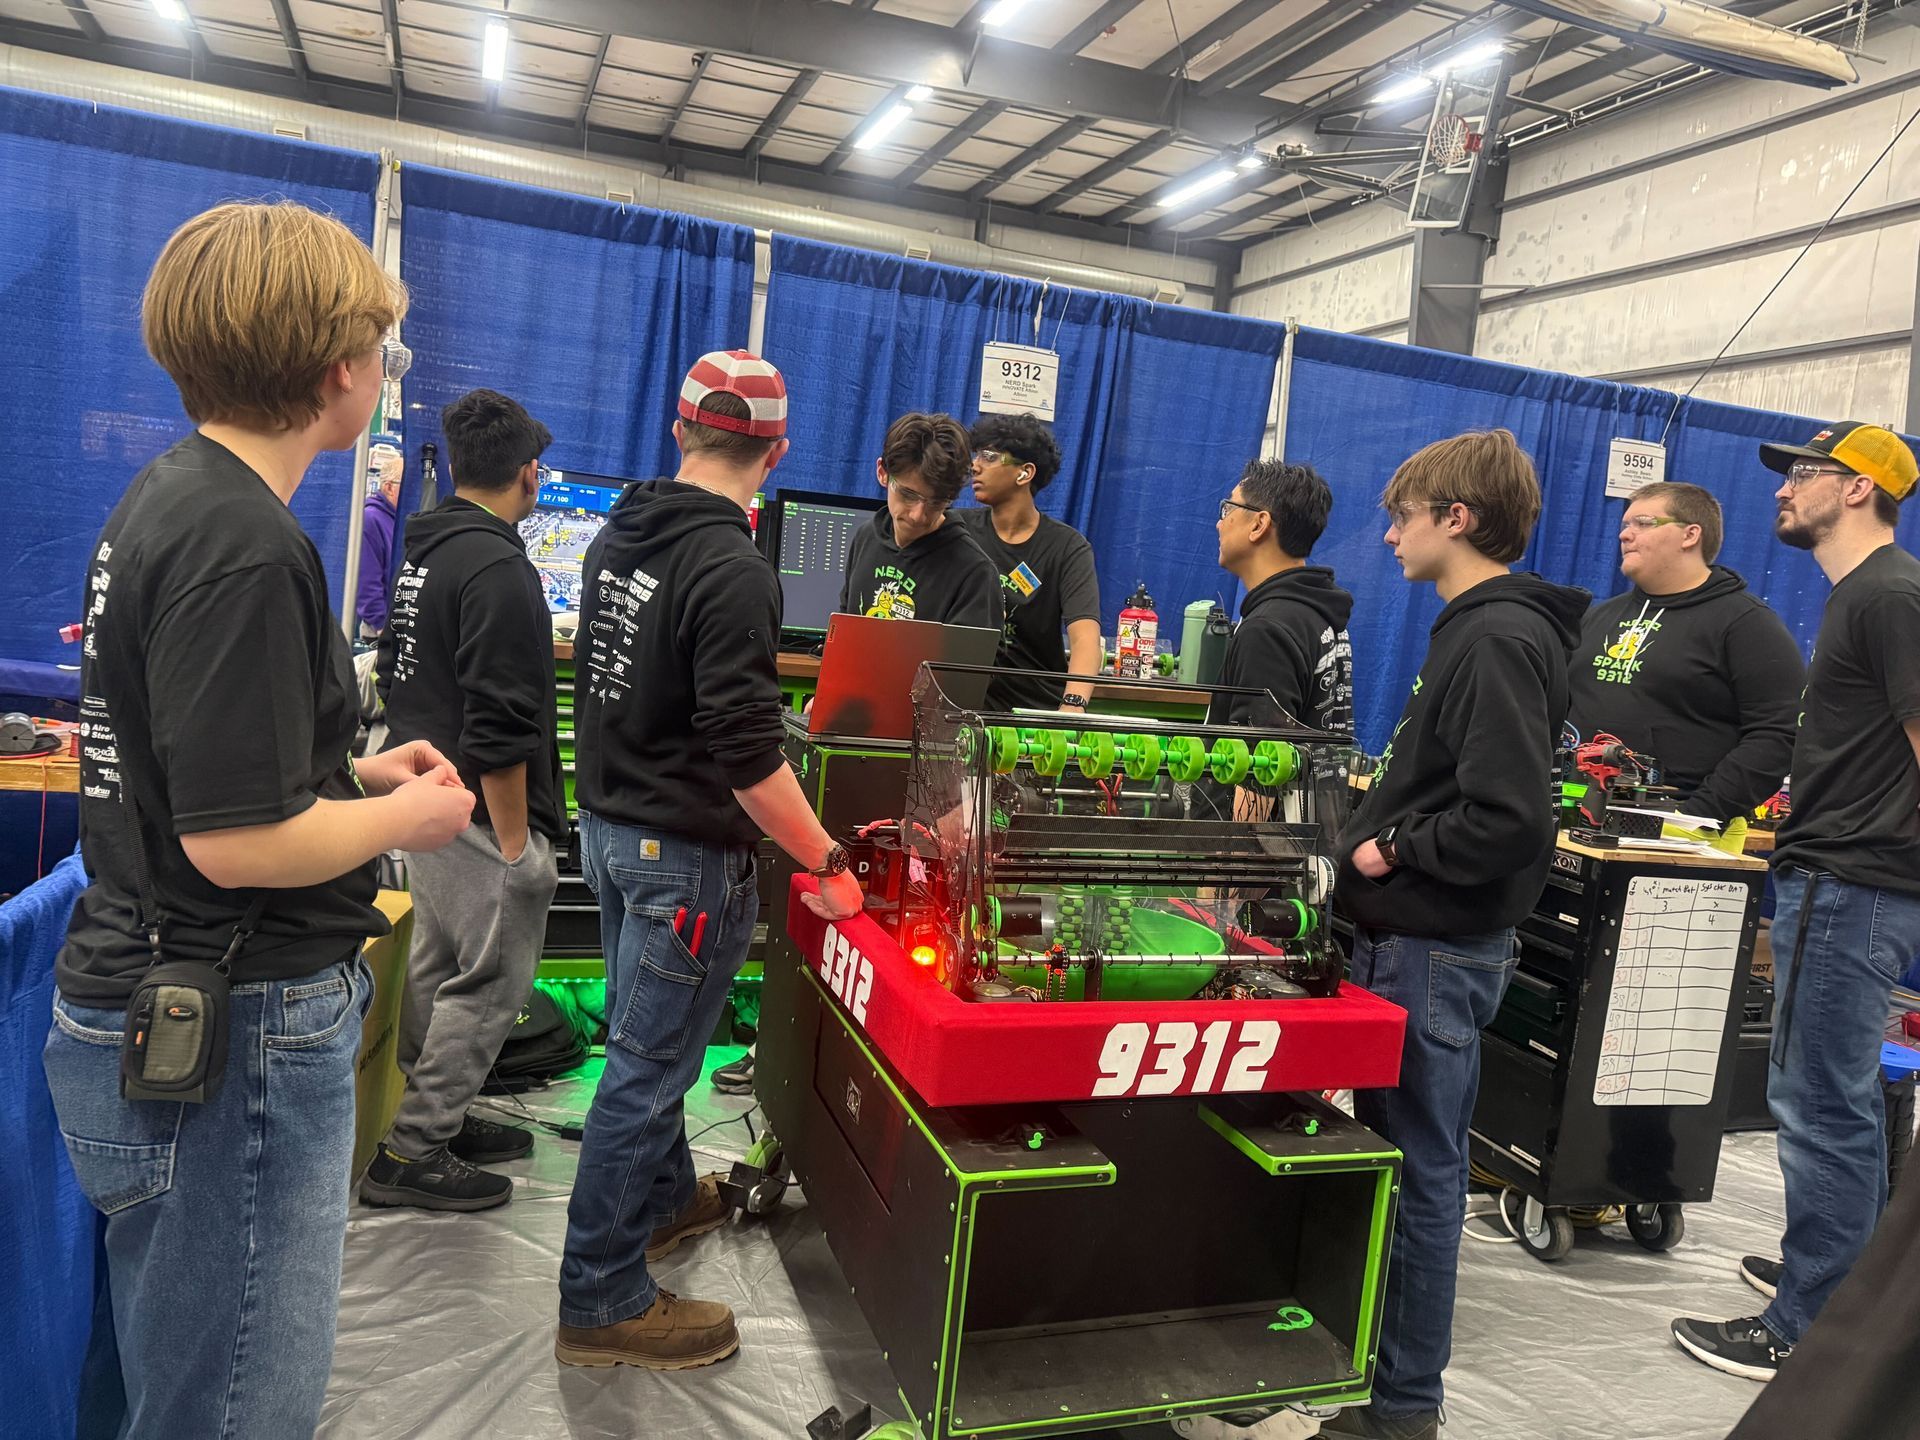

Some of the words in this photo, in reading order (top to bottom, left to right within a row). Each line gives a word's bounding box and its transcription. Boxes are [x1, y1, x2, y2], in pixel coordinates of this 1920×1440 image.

[1002, 361, 1041, 381] 9312
[1623, 454, 1654, 470] 9594
[894, 605, 910, 617] 9312
[616, 653, 632, 666] leidos
[1597, 668, 1632, 684] 9312
[91, 732, 114, 741] Steel
[1553, 853, 1579, 871] KON
[1708, 914, 1715, 925] 4
[820, 923, 874, 1028] 9312
[1750, 963, 1771, 973] FIRST
[1614, 970, 1628, 985] 32
[1633, 969, 1643, 985] 3
[1611, 992, 1625, 1008] 38
[1603, 1033, 1619, 1052] 53
[1091, 1020, 1282, 1097] 9312
[1601, 1057, 1616, 1074] 58
